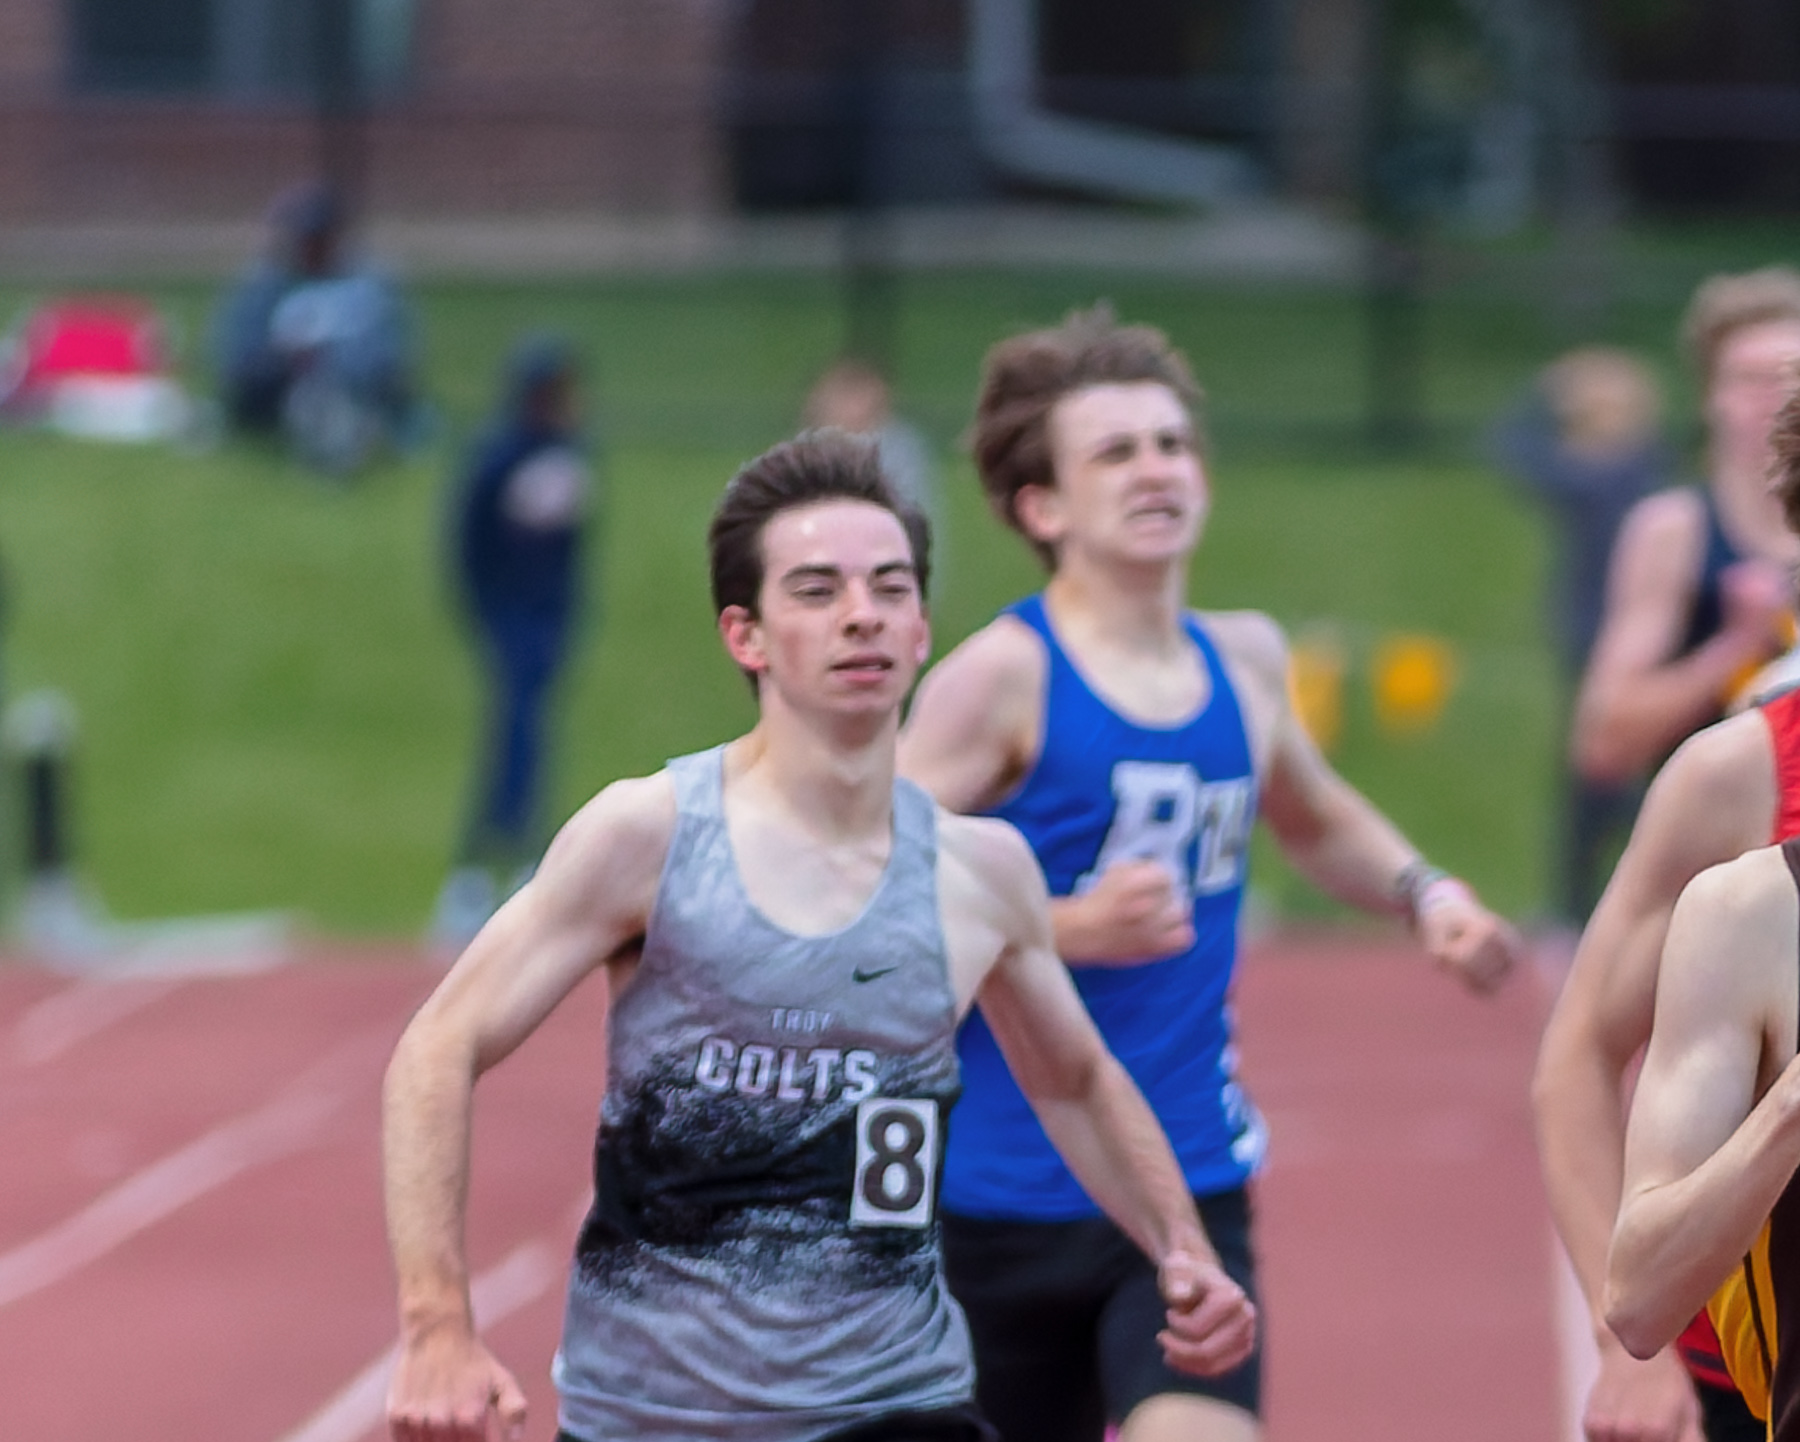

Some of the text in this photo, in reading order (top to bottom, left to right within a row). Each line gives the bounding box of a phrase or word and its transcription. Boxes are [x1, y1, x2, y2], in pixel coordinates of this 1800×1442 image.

[770, 1007, 832, 1032] TROY
[693, 1034, 882, 1101] COLTS
[863, 1111, 925, 1212] 8
